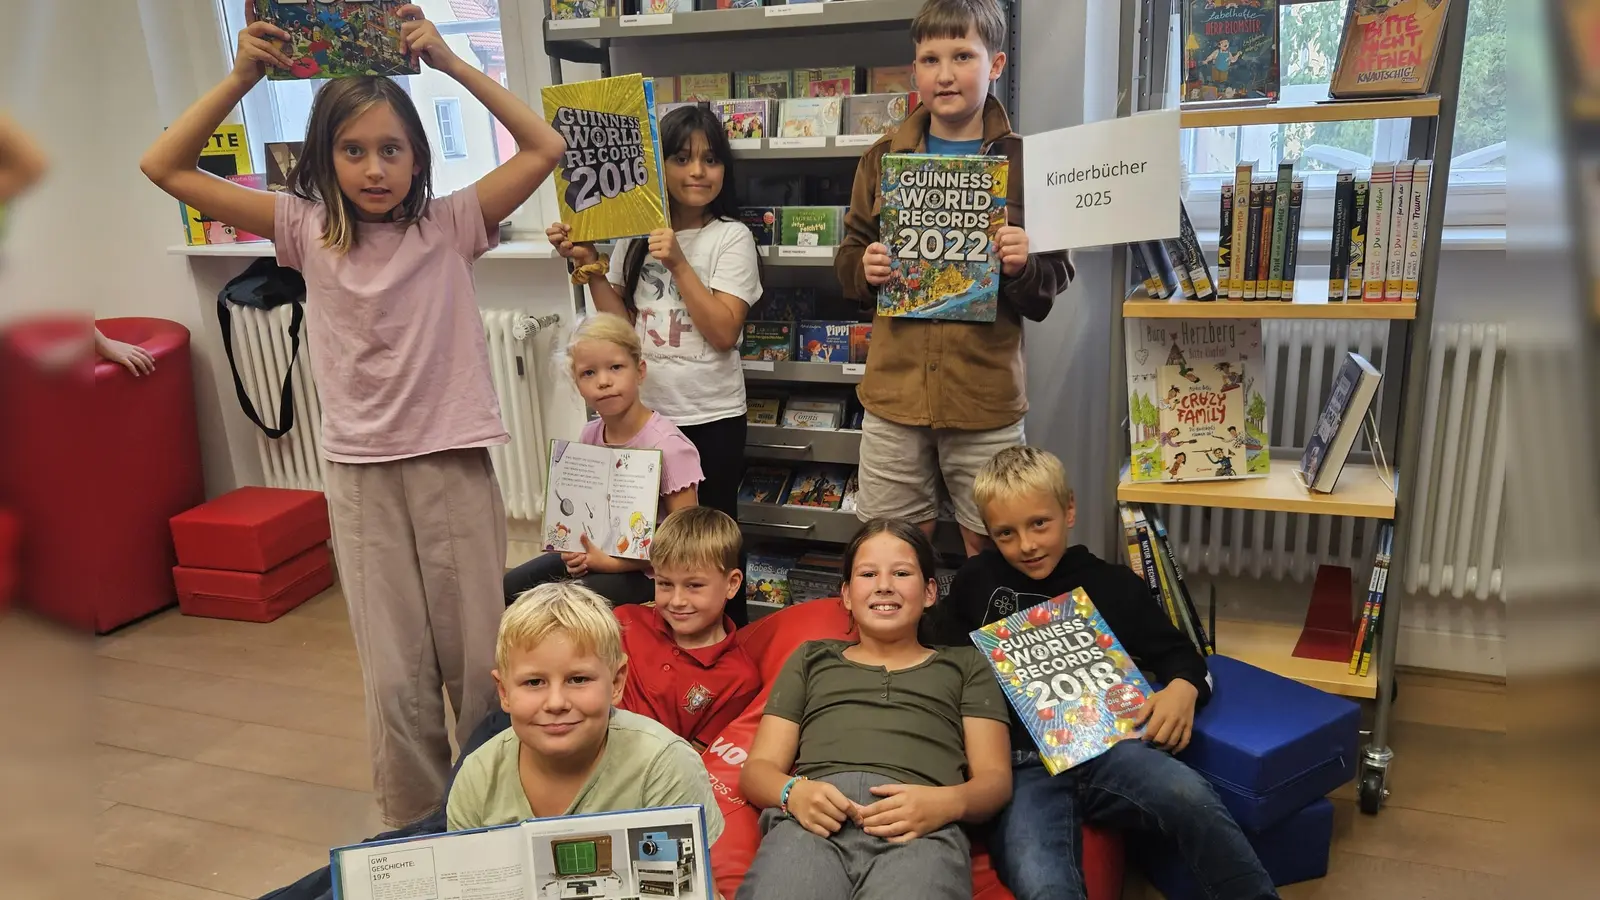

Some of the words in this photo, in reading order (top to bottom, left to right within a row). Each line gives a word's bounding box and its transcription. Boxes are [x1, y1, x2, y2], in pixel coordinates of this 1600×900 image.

[1364, 13, 1417, 40] BITTE
[1356, 66, 1417, 84] KNAUTSCHIG!
[557, 107, 640, 129] GUINNESS
[559, 125, 643, 149] WORLD
[565, 144, 645, 168] RECORDS
[570, 156, 649, 213] 2016
[899, 171, 993, 190] GUINNESS
[1046, 159, 1148, 187] Kinderbücher
[900, 189, 992, 211] WORLD
[1075, 190, 1112, 209] 2025
[1412, 191, 1421, 220] Traum!
[898, 210, 990, 229] RECORDS
[898, 228, 989, 262] 2022
[1373, 237, 1381, 249] Du
[1394, 238, 1402, 249] Du
[1146, 325, 1165, 346] Burg
[1181, 321, 1236, 348] Herzberg
[1181, 391, 1227, 409] CRAZY
[1142, 540, 1151, 560] NATUR
[1147, 565, 1158, 589] TECHNIK
[998, 618, 1086, 652] GUINNESS
[1004, 631, 1095, 668] WORLD
[1013, 646, 1105, 682] RECORDS
[1025, 661, 1122, 711] 2018
[371, 861, 416, 872] GESCHICHTE:
[373, 873, 391, 881] 1975
